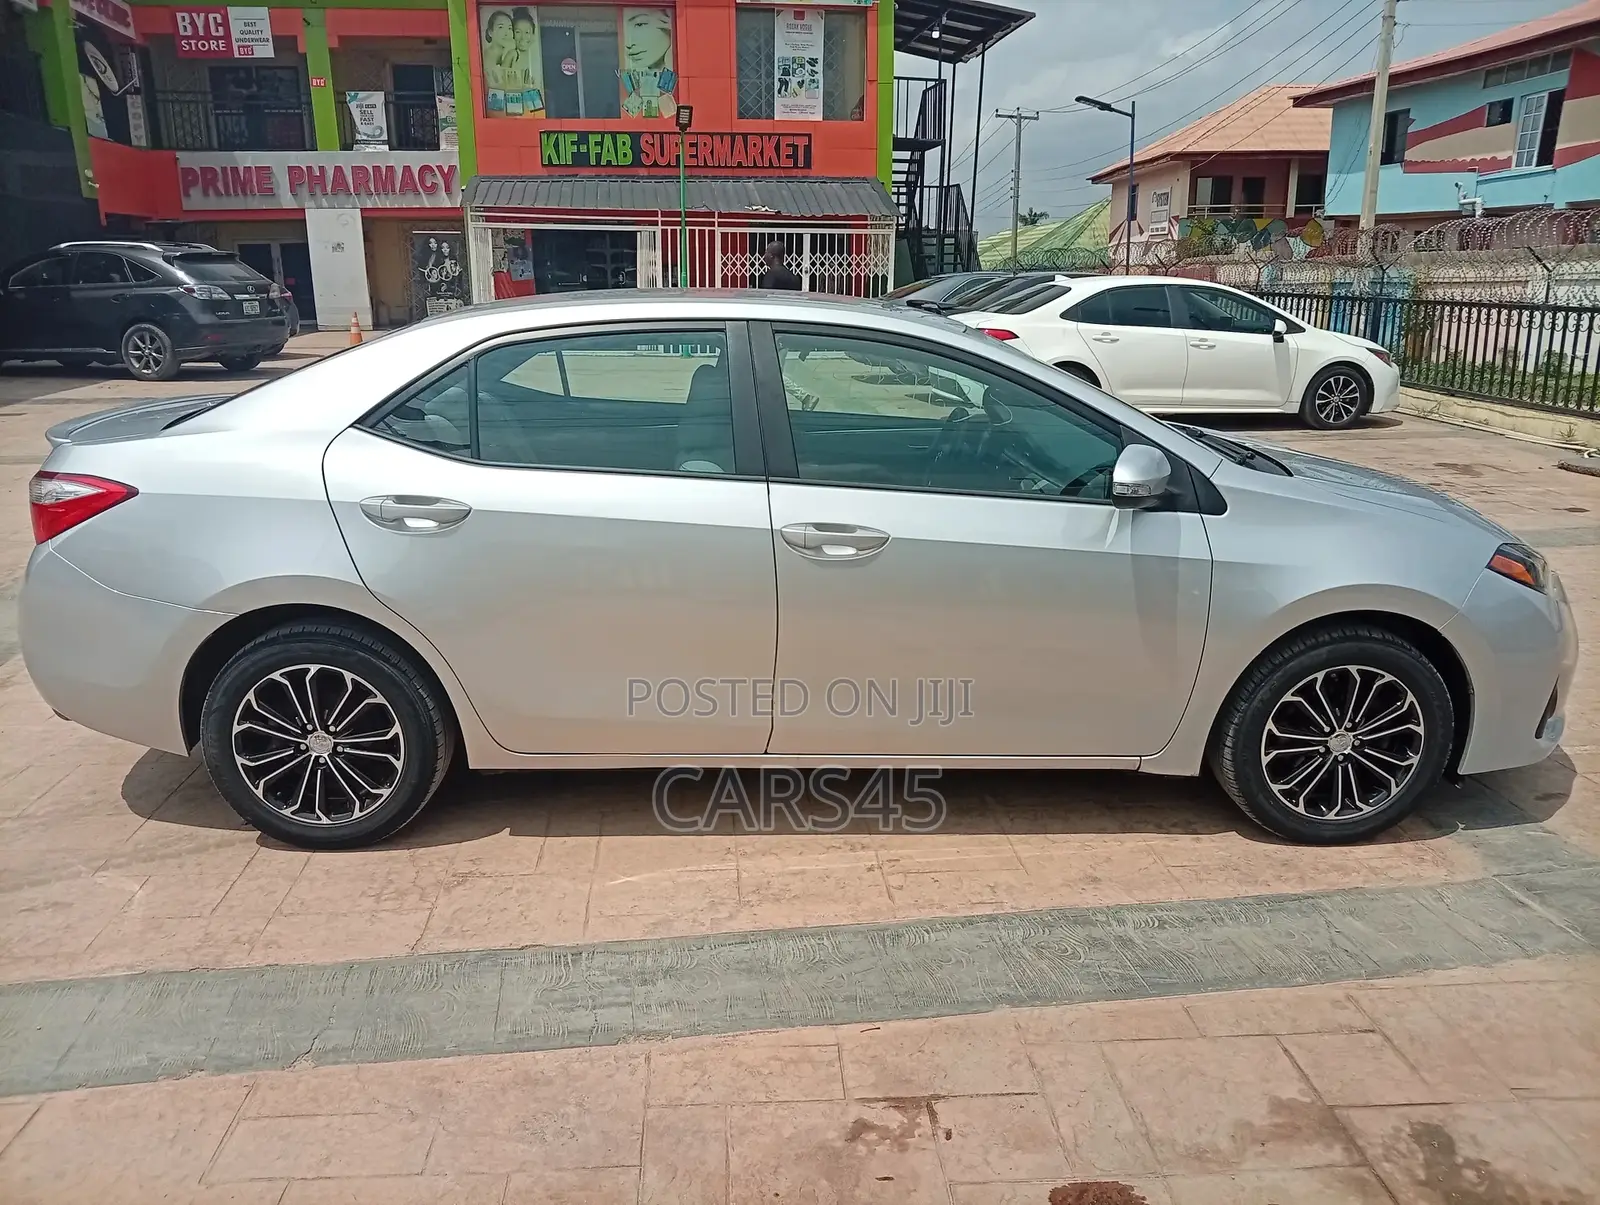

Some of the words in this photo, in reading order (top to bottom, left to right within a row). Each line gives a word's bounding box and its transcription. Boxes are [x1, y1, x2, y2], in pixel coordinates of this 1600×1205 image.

[175, 12, 224, 36] BYC
[181, 40, 227, 51] STORE
[239, 47, 253, 55] BYC
[312, 78, 325, 86] BYC
[541, 132, 633, 165] KIF-FAB
[640, 132, 809, 168] SUPERMARKET
[180, 165, 275, 197] PRIME
[287, 164, 456, 195] PHARMACY
